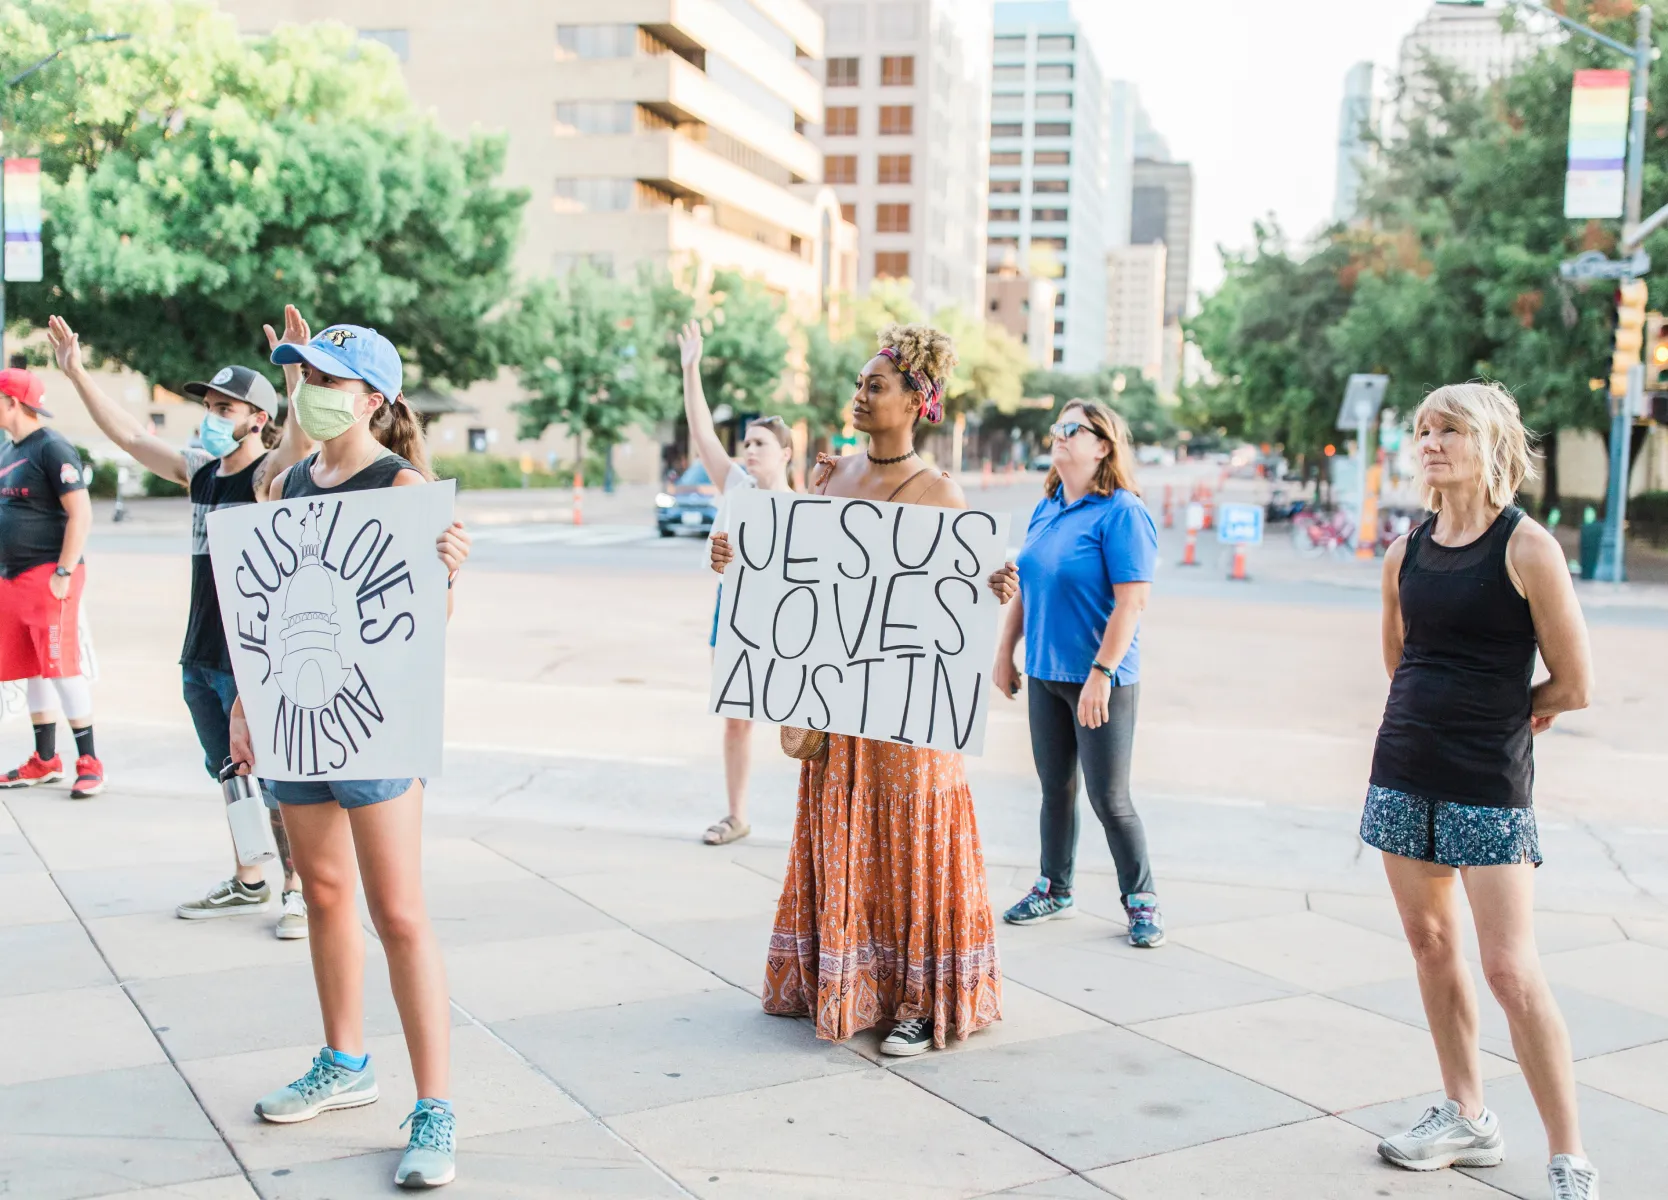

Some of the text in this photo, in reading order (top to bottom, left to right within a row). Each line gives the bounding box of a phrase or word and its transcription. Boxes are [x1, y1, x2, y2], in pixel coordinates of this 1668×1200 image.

[738, 497, 997, 584] JESUS
[235, 501, 415, 685] JESUS LOVES
[729, 565, 979, 659] LOVES
[273, 662, 385, 777] AUSTIN
[714, 649, 982, 750] AUSTIN
